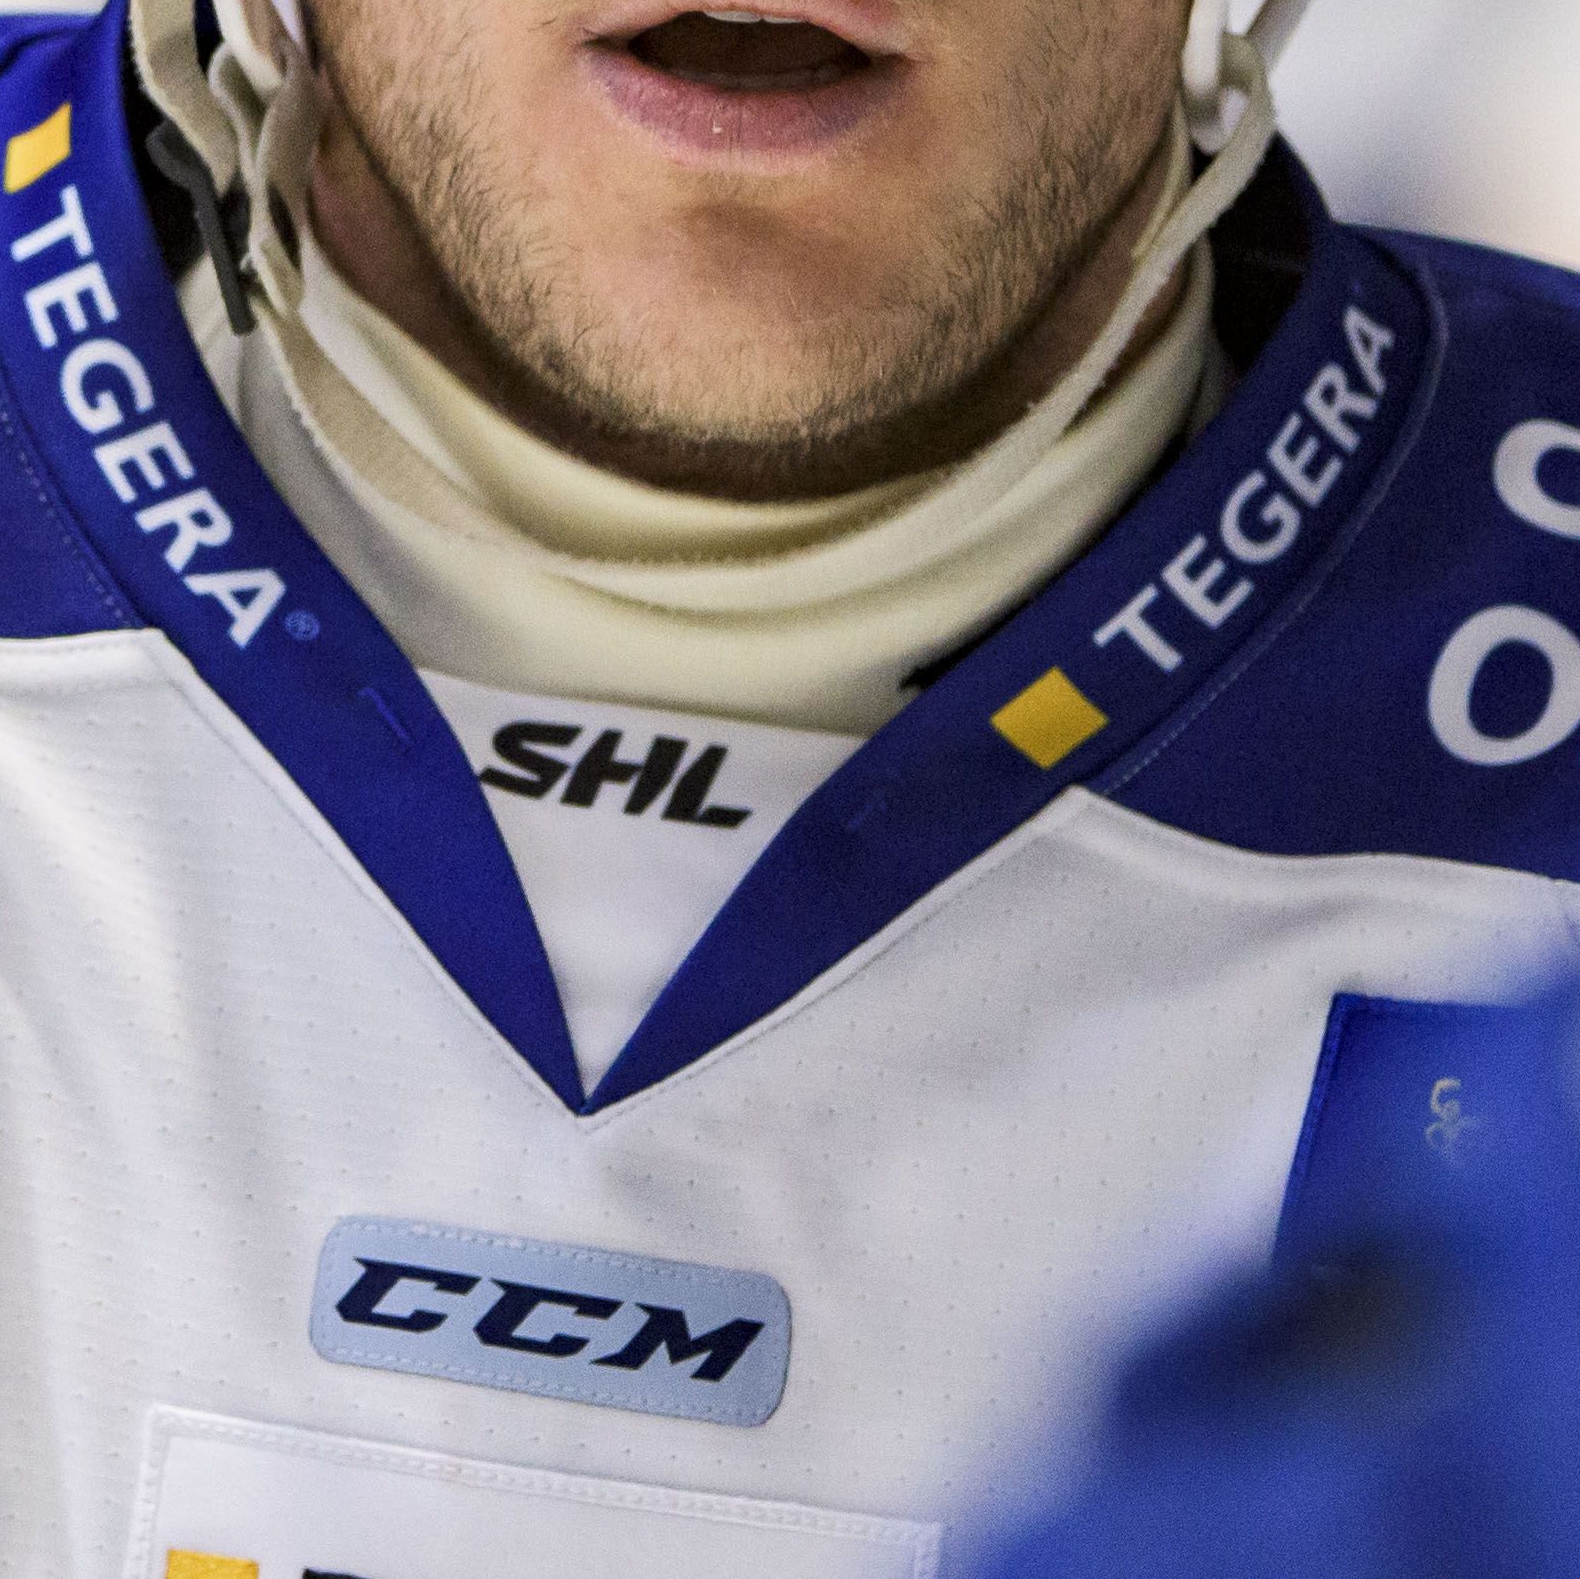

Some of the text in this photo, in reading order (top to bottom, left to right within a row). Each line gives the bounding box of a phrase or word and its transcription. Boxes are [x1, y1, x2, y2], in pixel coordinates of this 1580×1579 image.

[1092, 304, 1394, 673] TEGERA
[479, 720, 754, 830] SHL
[334, 1256, 768, 1384] CCM
